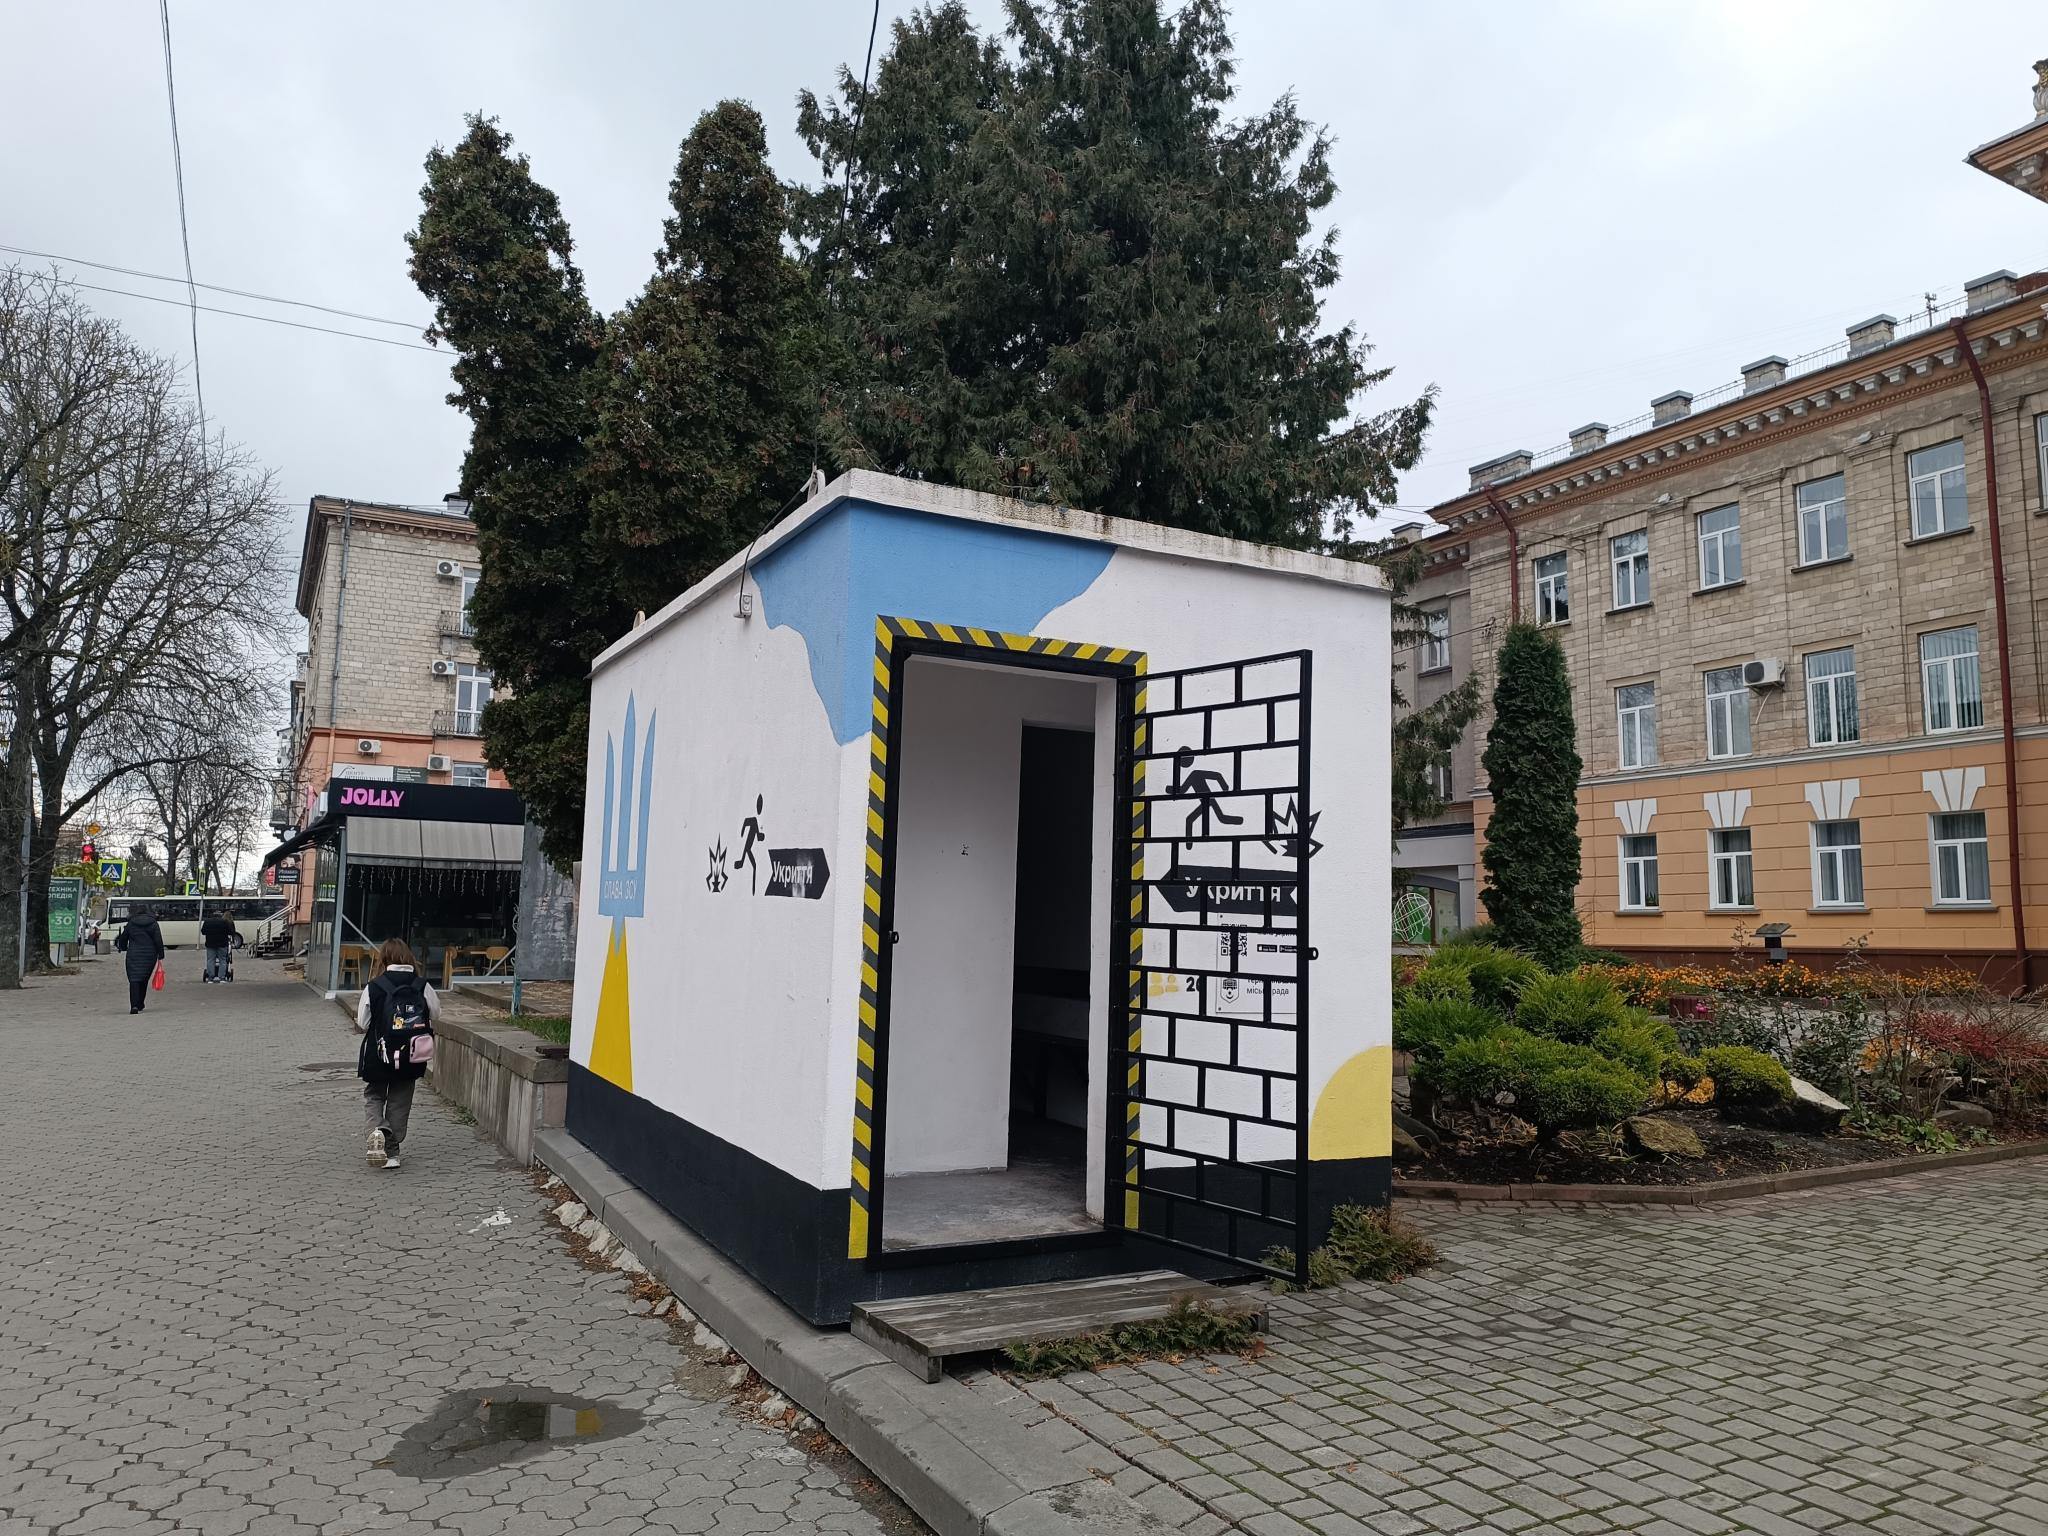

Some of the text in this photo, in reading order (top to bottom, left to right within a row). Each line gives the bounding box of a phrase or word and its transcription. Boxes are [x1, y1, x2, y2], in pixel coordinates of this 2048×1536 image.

[341, 787, 404, 807] JOLLY
[773, 861, 813, 888] Укриття
[604, 880, 638, 900] СЛАВА ЗСУ
